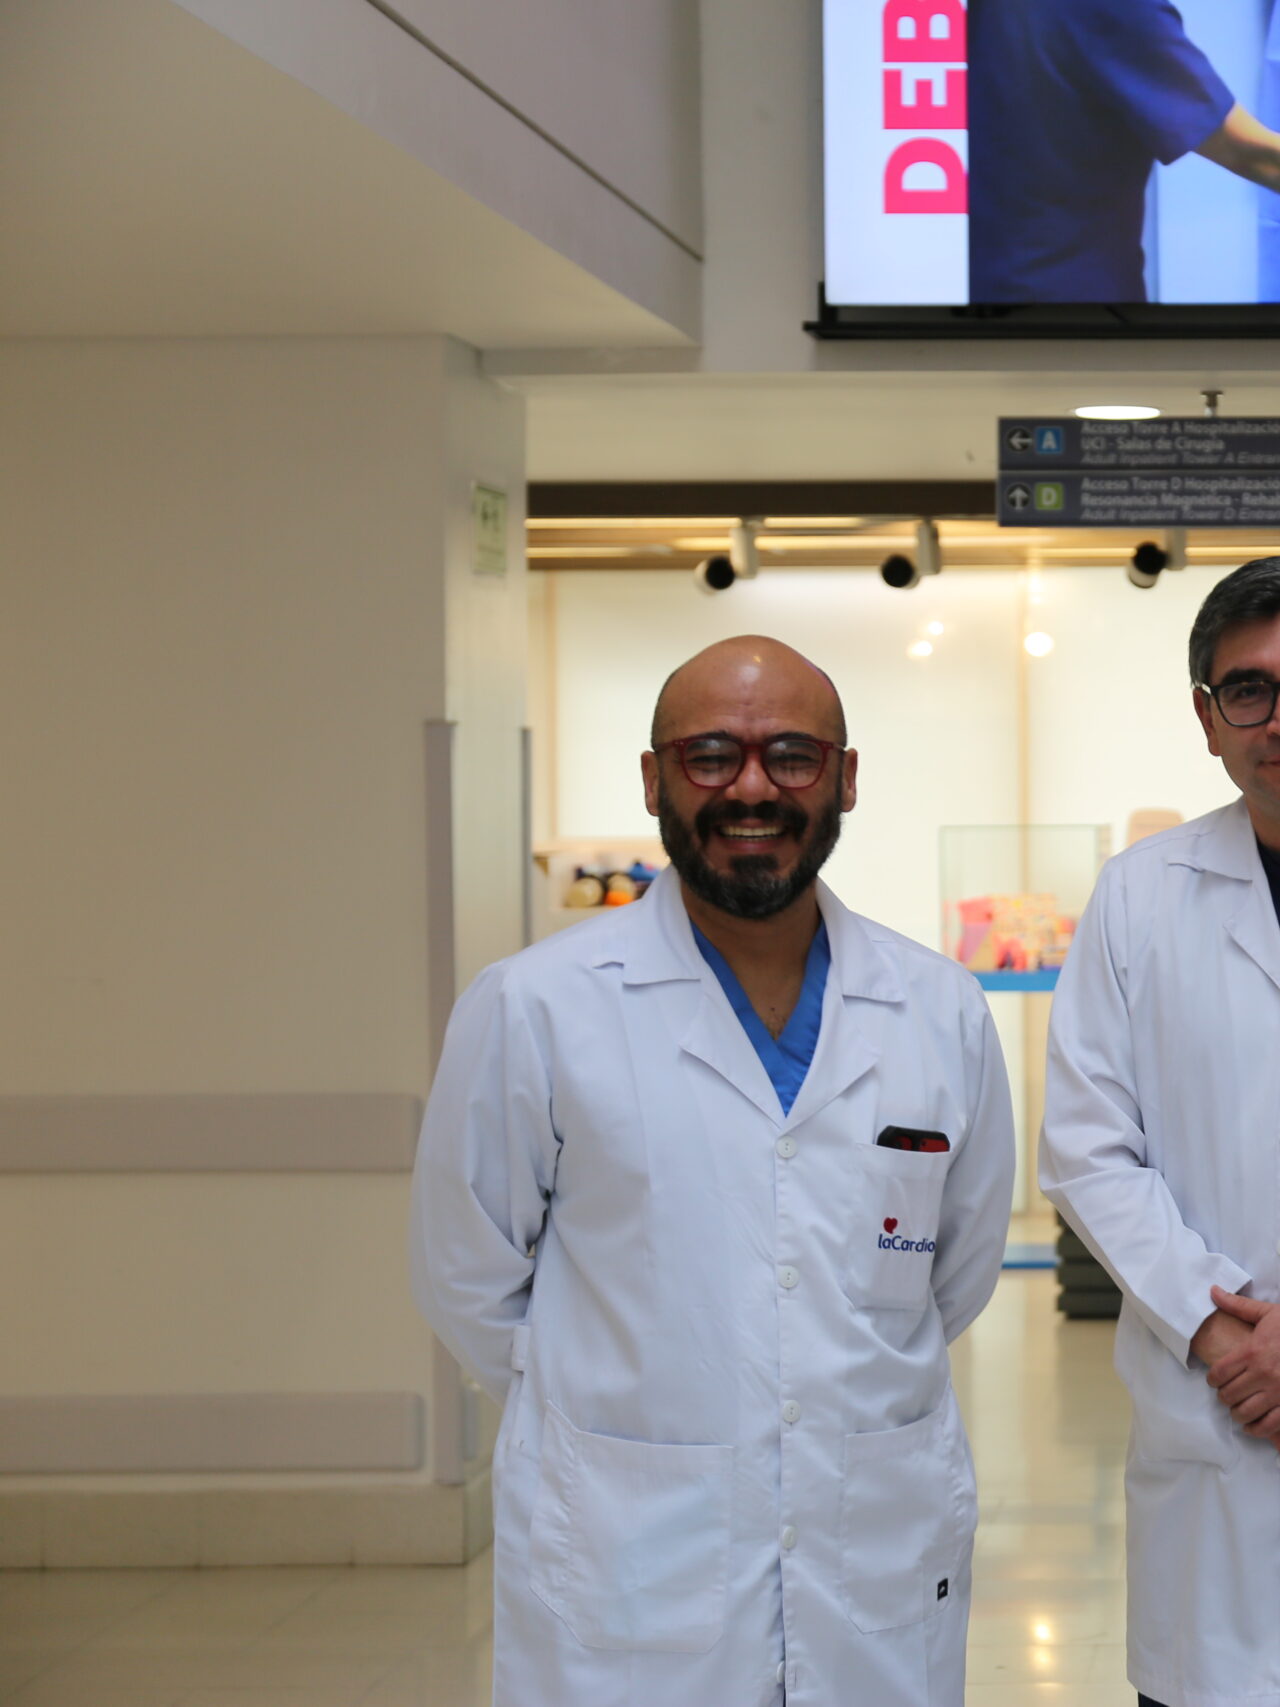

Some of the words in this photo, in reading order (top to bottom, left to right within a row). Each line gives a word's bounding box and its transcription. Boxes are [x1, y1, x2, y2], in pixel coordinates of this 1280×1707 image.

[1081, 423, 1128, 435] Acceso
[1132, 423, 1167, 435] Torre
[1171, 423, 1182, 435] A
[1041, 430, 1056, 449] A
[1116, 437, 1156, 450] Salas
[1159, 437, 1172, 450] de
[1081, 478, 1128, 490] Acceso
[1132, 478, 1168, 490] Torre
[1171, 478, 1181, 490] D
[1041, 487, 1056, 506] D
[878, 1233, 936, 1252] laCardio
